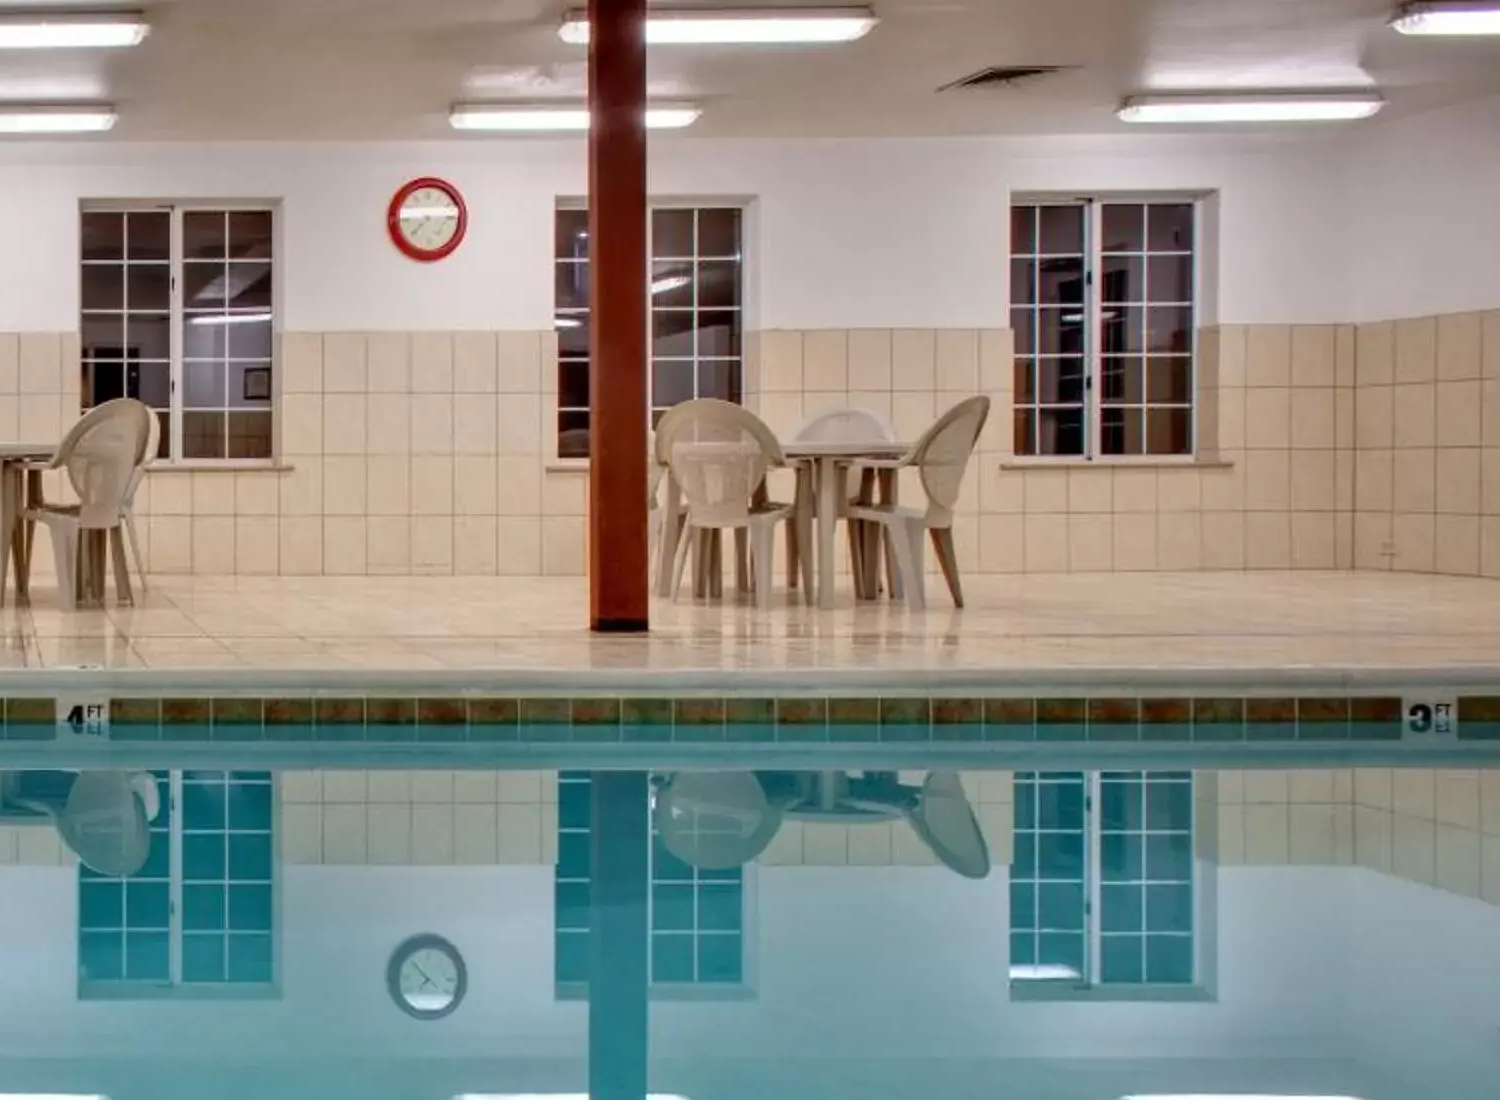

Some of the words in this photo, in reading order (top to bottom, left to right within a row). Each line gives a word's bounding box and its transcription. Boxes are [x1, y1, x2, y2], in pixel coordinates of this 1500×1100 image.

[67, 705, 83, 726] 4
[87, 704, 103, 719] FT
[1435, 703, 1451, 717] FT
